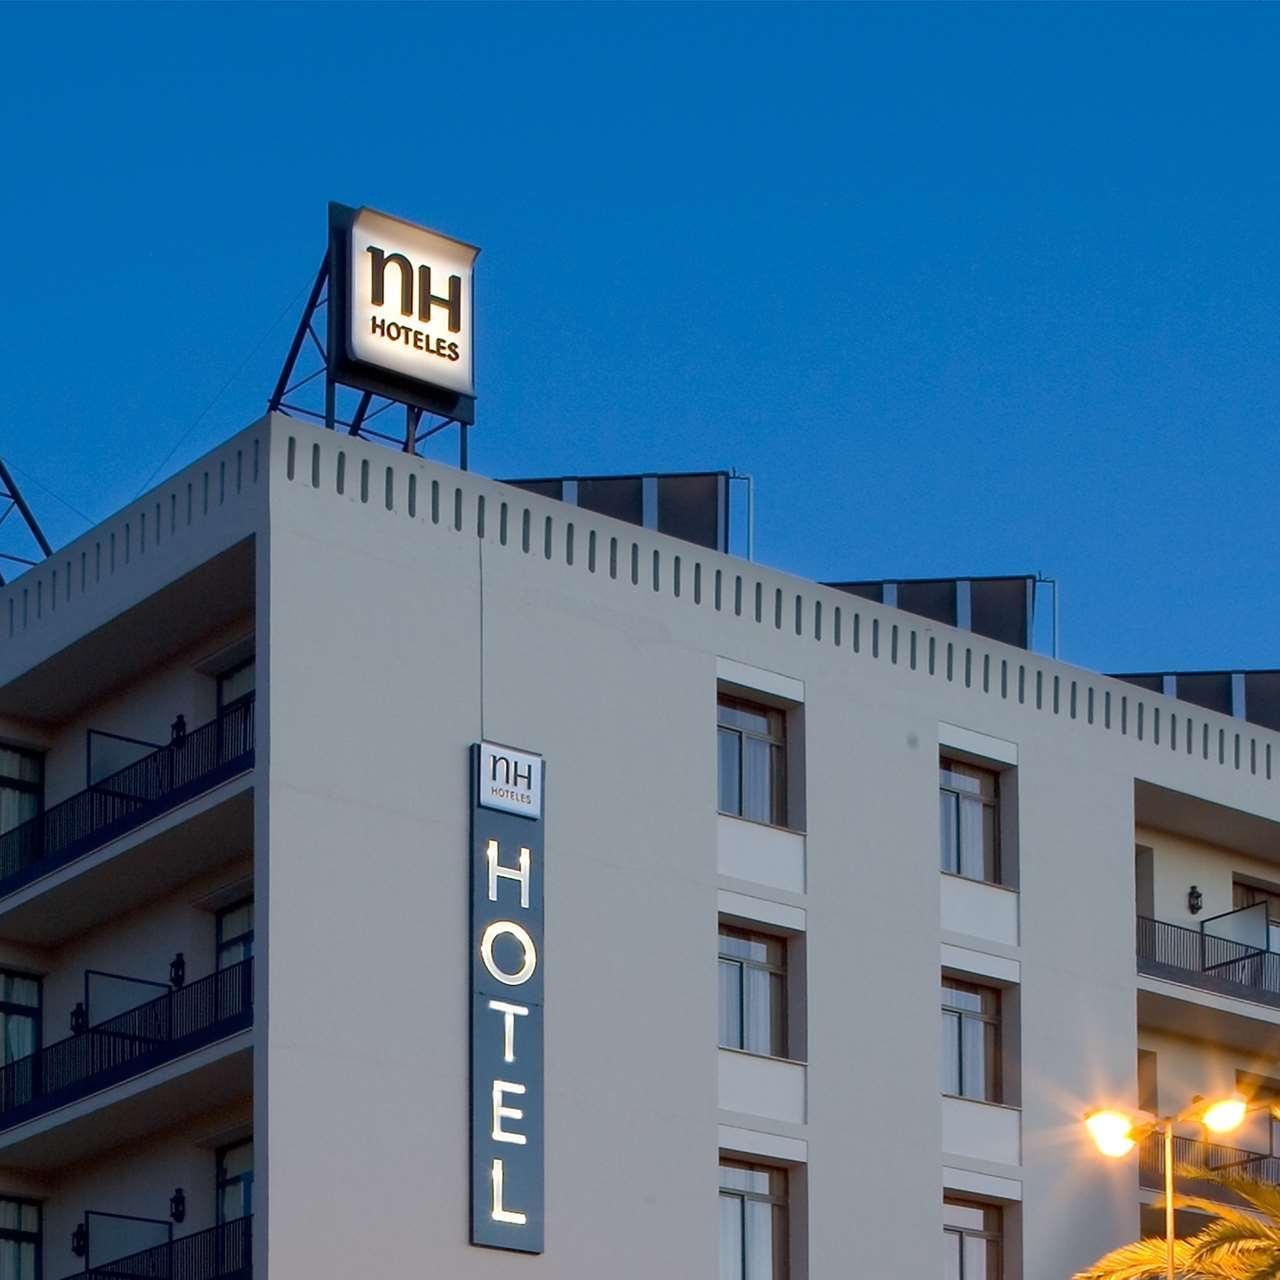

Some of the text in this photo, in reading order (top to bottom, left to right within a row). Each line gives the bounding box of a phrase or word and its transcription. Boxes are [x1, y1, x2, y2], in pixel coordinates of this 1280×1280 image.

[366, 245, 461, 333] nH
[371, 315, 460, 361] HOTELES
[490, 754, 532, 790] nH
[491, 786, 531, 804] HOTELES
[481, 840, 536, 1225] HOTEL
